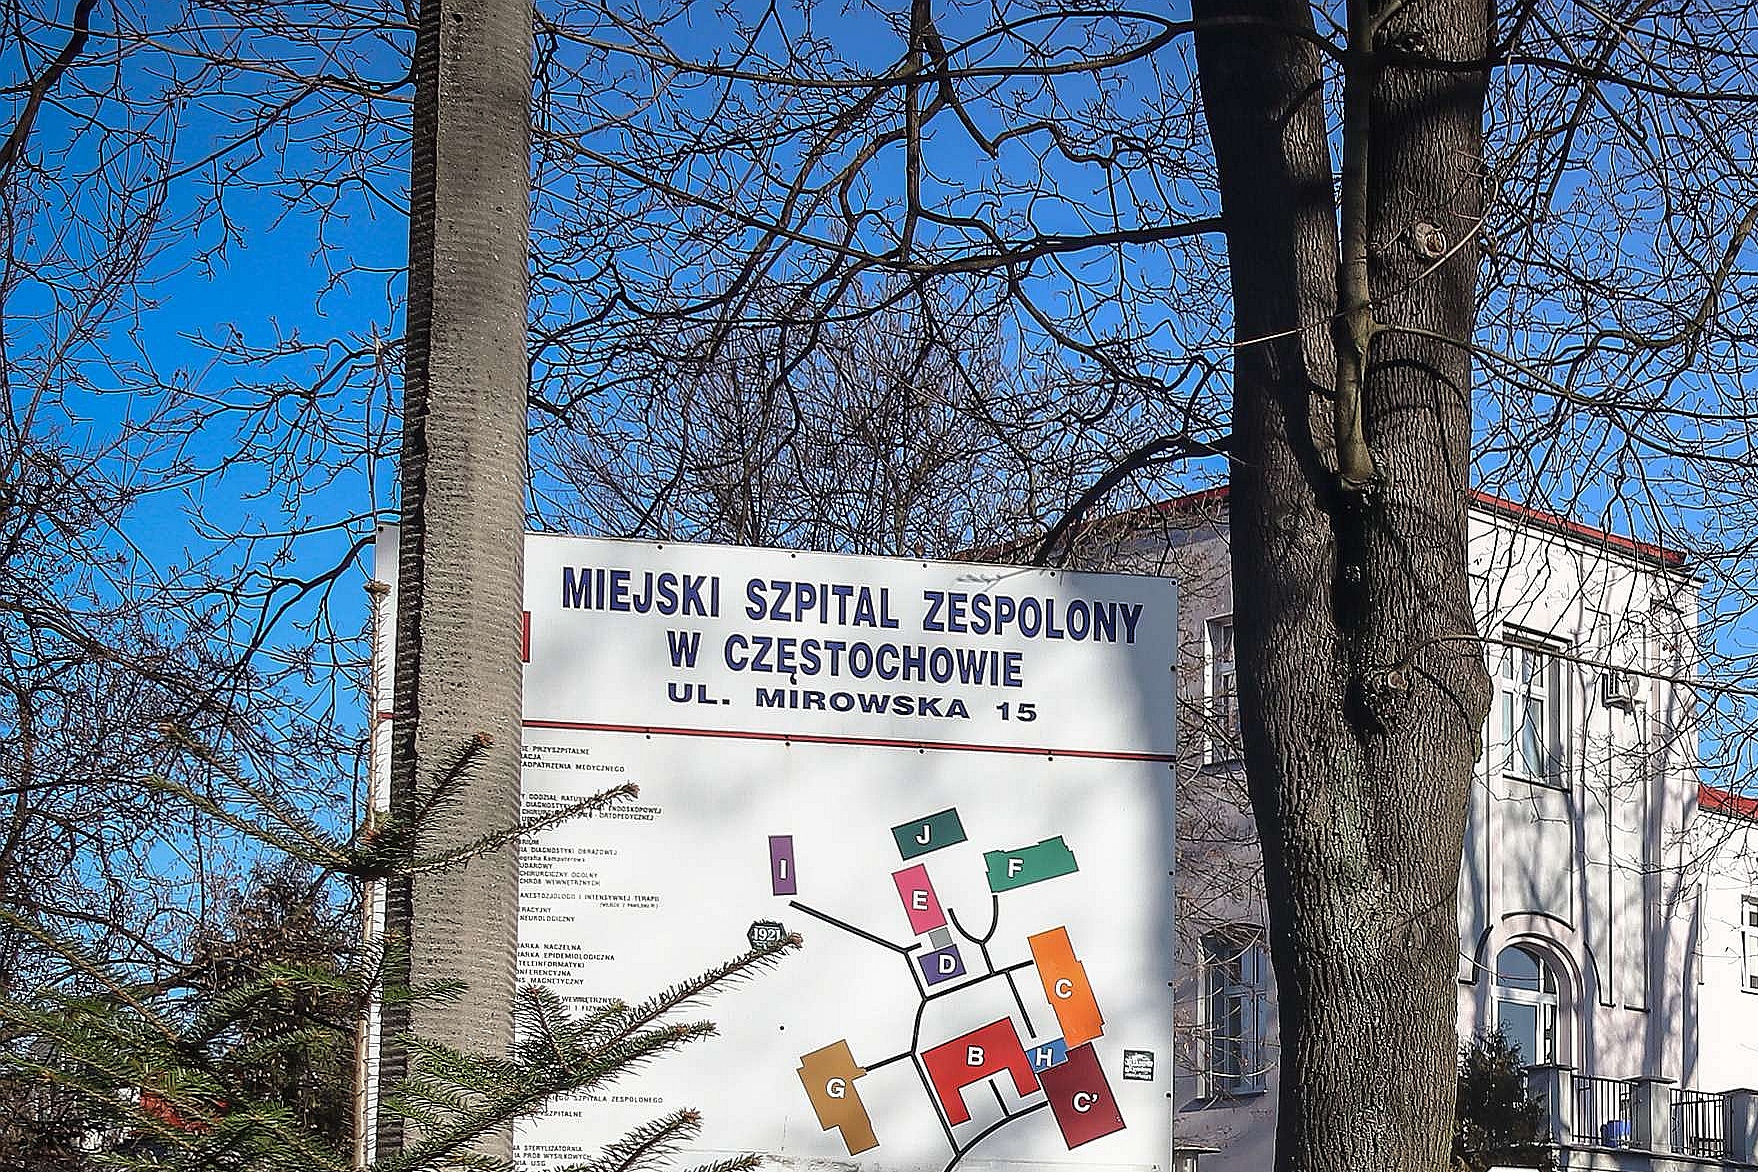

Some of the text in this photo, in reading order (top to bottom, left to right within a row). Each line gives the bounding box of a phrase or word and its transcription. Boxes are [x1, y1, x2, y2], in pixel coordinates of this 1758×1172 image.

[561, 566, 1145, 644] MIEJSKI SZPITAL ZESPOLONY
[667, 630, 1024, 688] W CZĘSTOCHOWIE
[667, 682, 1038, 723] UL. MIROWSKA 15
[915, 824, 933, 846] J
[779, 858, 788, 880] I
[1006, 858, 1024, 878] F
[911, 890, 929, 911] E
[753, 927, 781, 941] 1921
[937, 954, 957, 975] D
[1054, 978, 1074, 999] C
[966, 1046, 985, 1066] B
[1035, 1047, 1053, 1068] H
[825, 1077, 846, 1100] G
